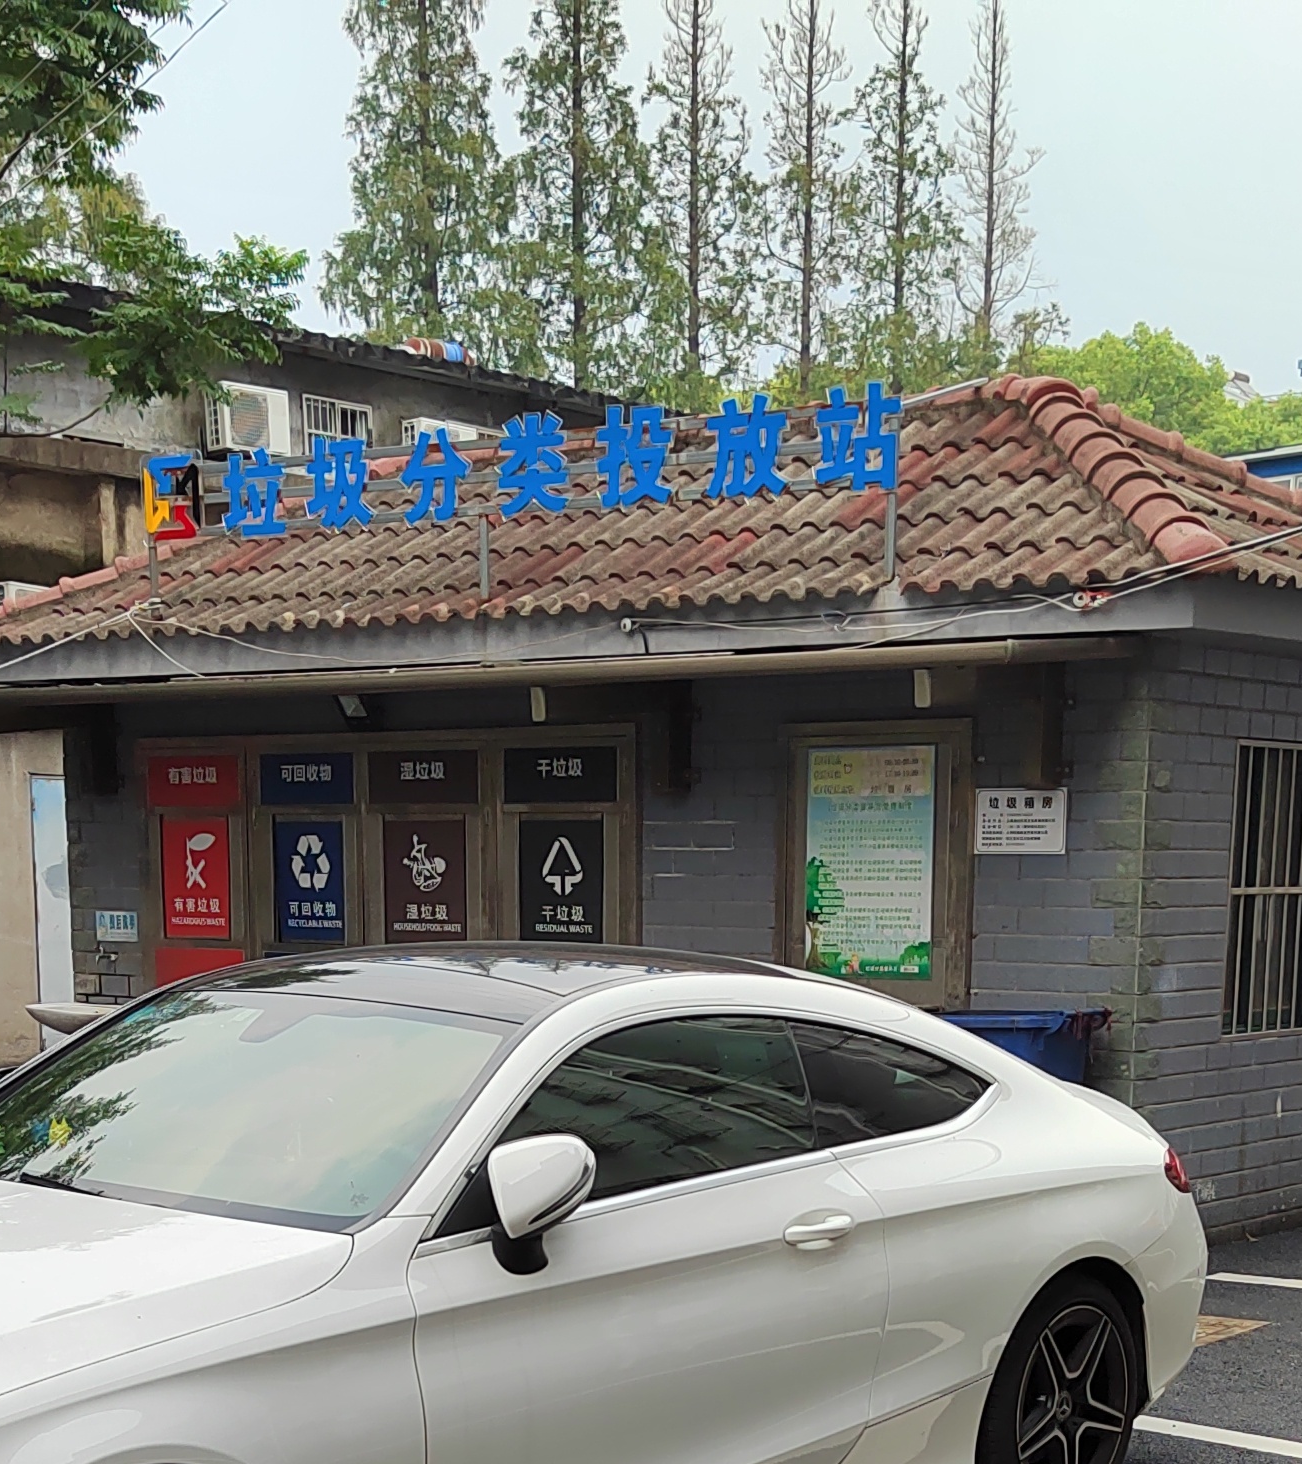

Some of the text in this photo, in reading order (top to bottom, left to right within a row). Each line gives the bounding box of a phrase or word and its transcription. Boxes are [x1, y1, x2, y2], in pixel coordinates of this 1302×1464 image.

[222, 380, 900, 538] 垃圾分类投放站
[168, 766, 217, 784] 有害垃圾
[280, 764, 332, 783] 可回收物
[400, 761, 445, 780] 湿垃圾
[536, 757, 583, 779] 干垃圾
[988, 796, 1053, 809] 垃圾箱房
[173, 897, 220, 914] 有害垃圾
[288, 901, 337, 917] 可回收物
[406, 903, 448, 920] 湿垃圾
[541, 904, 585, 922] 干垃圾
[206, 917, 226, 926] WASTE
[535, 923, 593, 934] RESIDUAL WASTE
